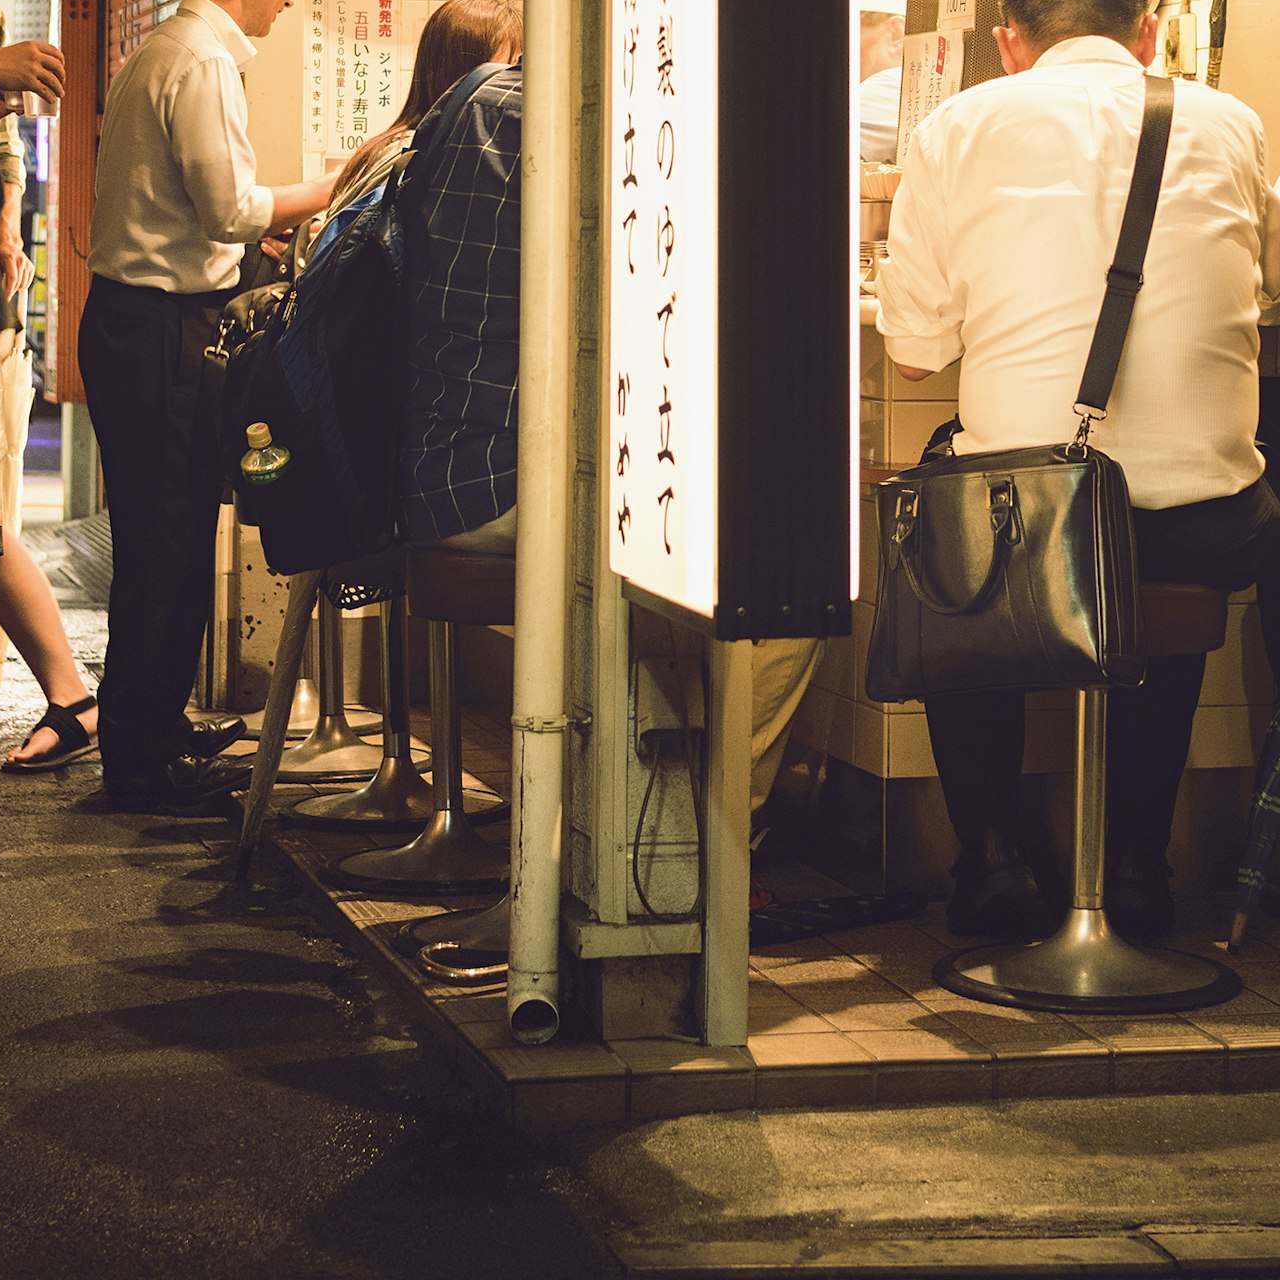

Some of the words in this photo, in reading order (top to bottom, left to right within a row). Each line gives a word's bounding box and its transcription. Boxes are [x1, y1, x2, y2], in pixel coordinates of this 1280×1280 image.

[352, 11, 370, 135] 五目いなり寿司
[378, 51, 392, 108] ジャンボ
